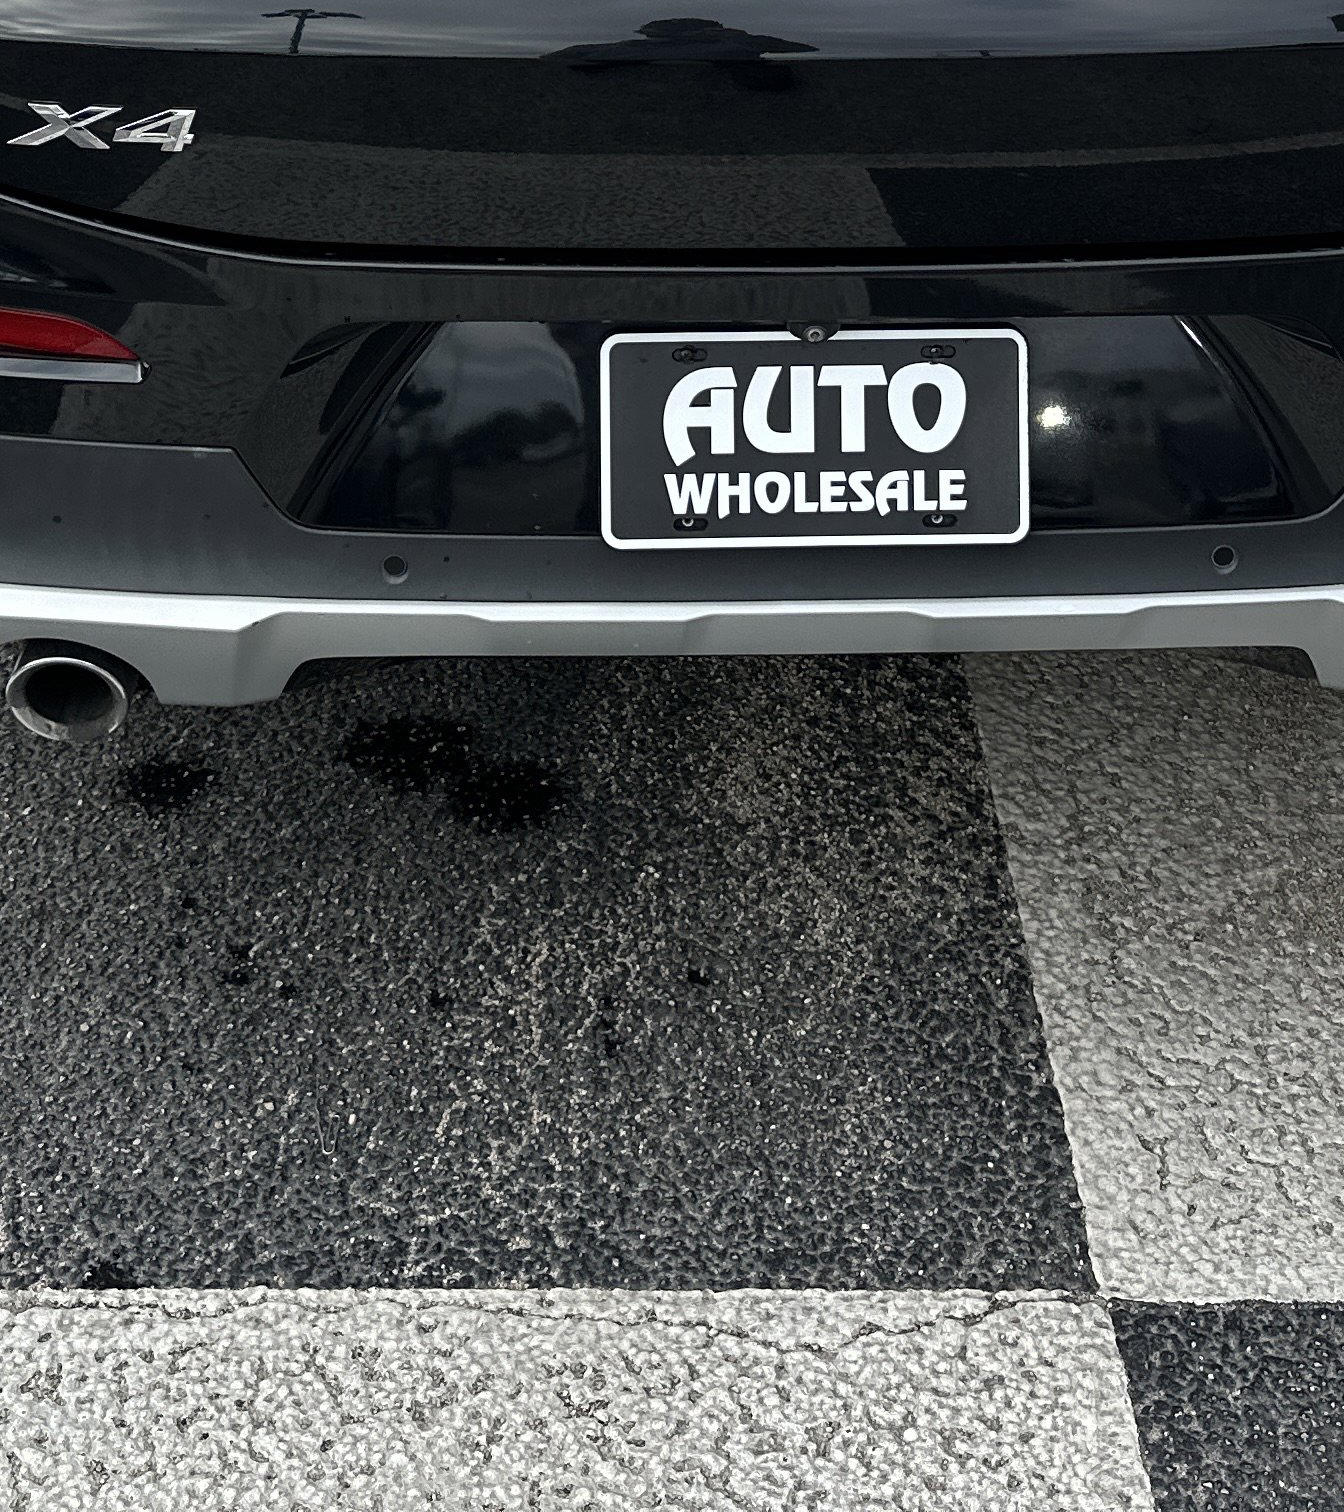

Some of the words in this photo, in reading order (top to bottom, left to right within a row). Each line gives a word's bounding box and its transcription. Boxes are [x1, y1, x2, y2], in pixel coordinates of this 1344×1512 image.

[6, 100, 197, 153] X4
[662, 361, 968, 467] AUTO
[663, 468, 968, 520] WHOLESALE
